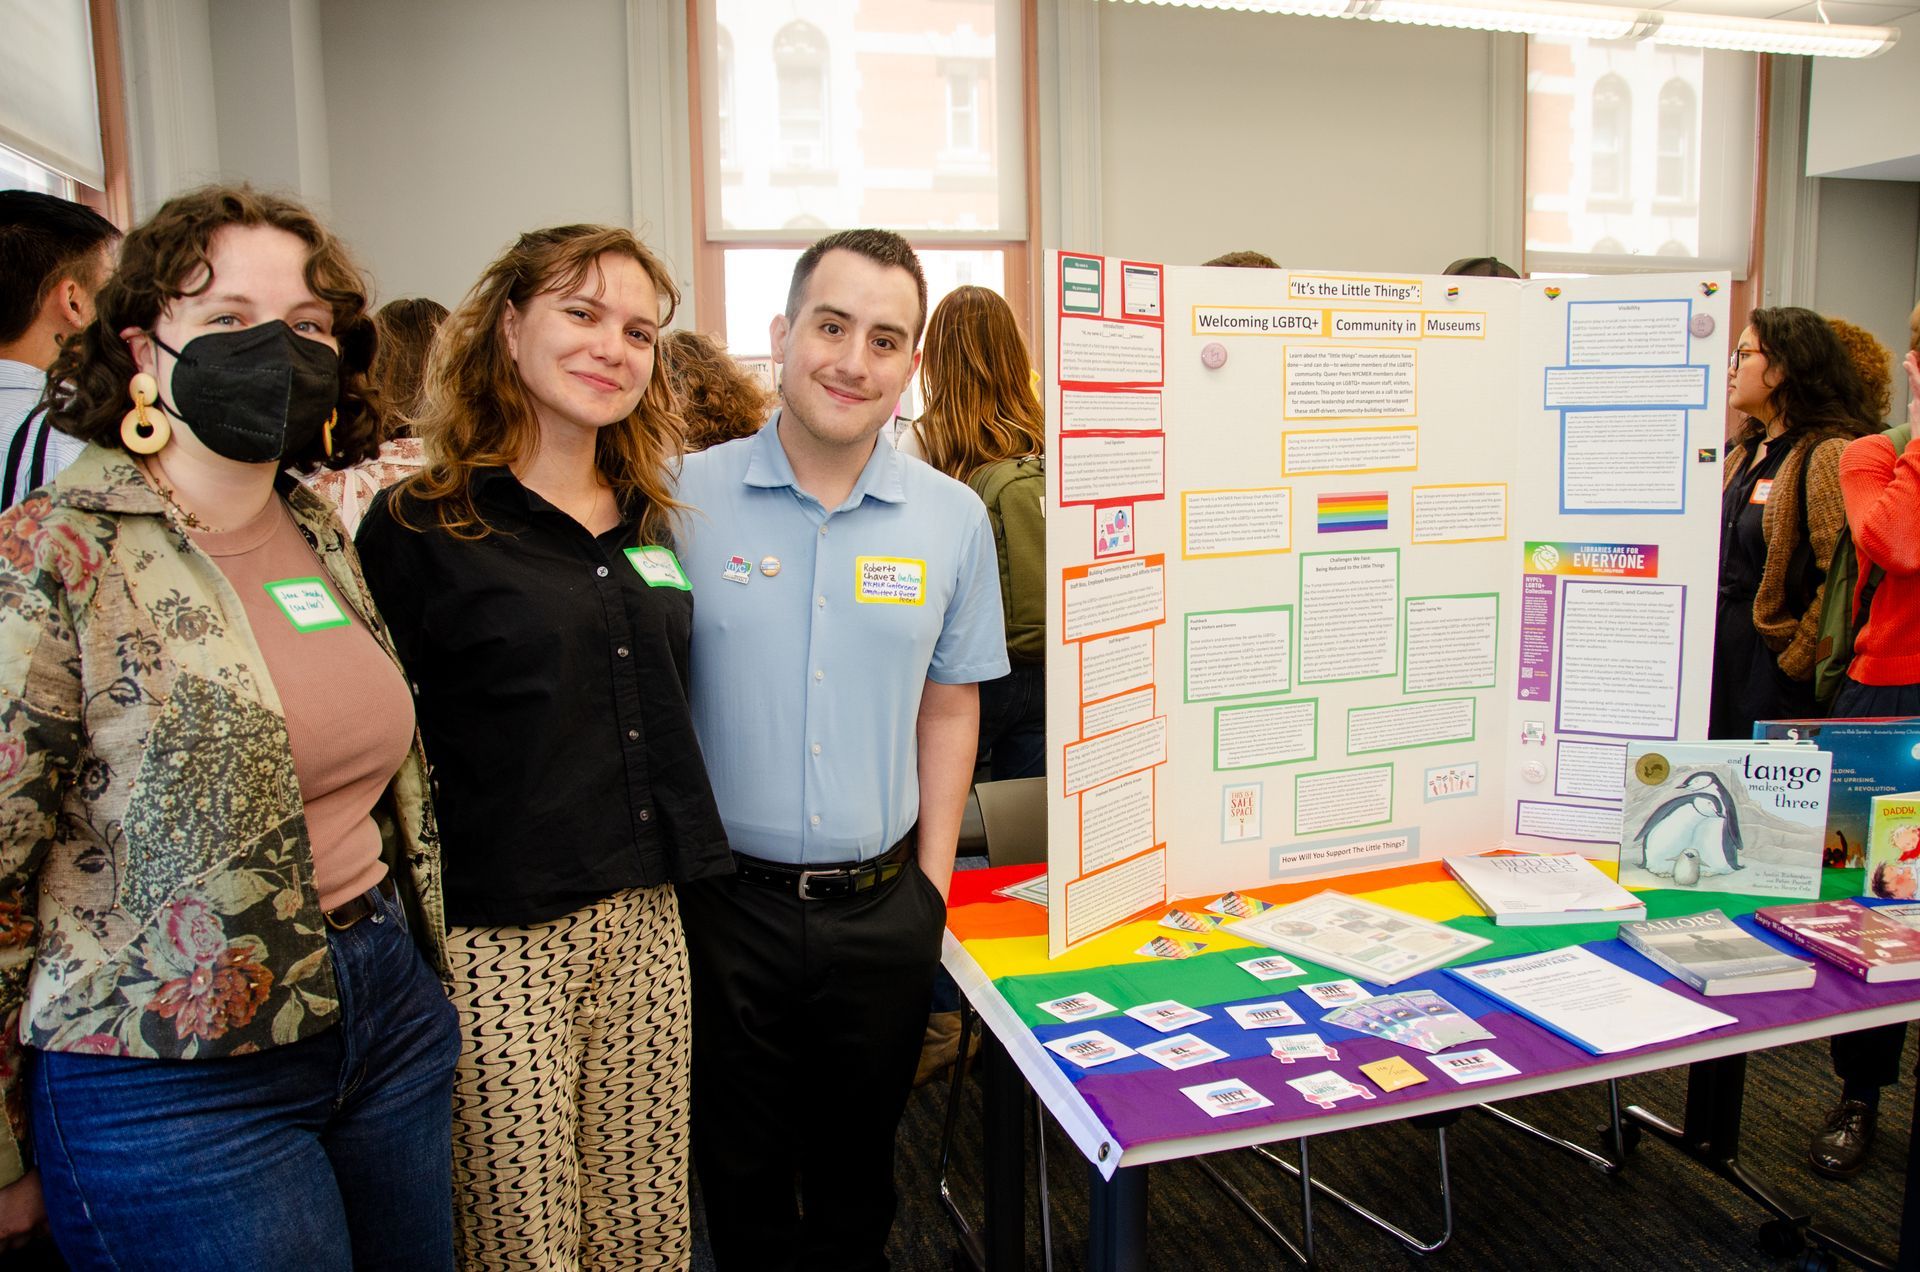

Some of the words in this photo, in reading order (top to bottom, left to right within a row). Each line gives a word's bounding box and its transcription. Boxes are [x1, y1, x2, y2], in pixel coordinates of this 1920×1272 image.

[1319, 283, 1338, 295] the
[1342, 284, 1370, 296] Little
[1199, 315, 1268, 330] Welcoming
[1272, 316, 1319, 330] LGBTQ+
[1336, 319, 1403, 333] Community
[1406, 320, 1416, 331] in
[1428, 320, 1480, 331] Museums
[864, 563, 896, 572] Roberto
[1573, 553, 1645, 569] EVERYONE
[1744, 753, 1821, 790] tango
[1749, 782, 1785, 792] makes
[1231, 797, 1253, 808] SAFE
[1775, 794, 1818, 809] three
[1231, 807, 1253, 817] SPACE
[1326, 849, 1351, 858] Support
[1366, 844, 1381, 852] Little
[1383, 840, 1406, 849] Things?
[1490, 857, 1572, 870] HIDDEN
[1498, 863, 1578, 874] VOICES
[1632, 913, 1721, 933] SAILORS
[1755, 912, 1771, 927] Empty
[1772, 920, 1793, 939] Without
[1794, 933, 1805, 944] You
[1256, 960, 1275, 969] HE
[1316, 984, 1345, 995] SHE
[1055, 998, 1084, 1010] SHE
[1251, 1009, 1283, 1020] THEY
[1070, 1041, 1102, 1054] SHE
[1449, 1056, 1486, 1067] ELLE
[1212, 1089, 1247, 1104] THEY
